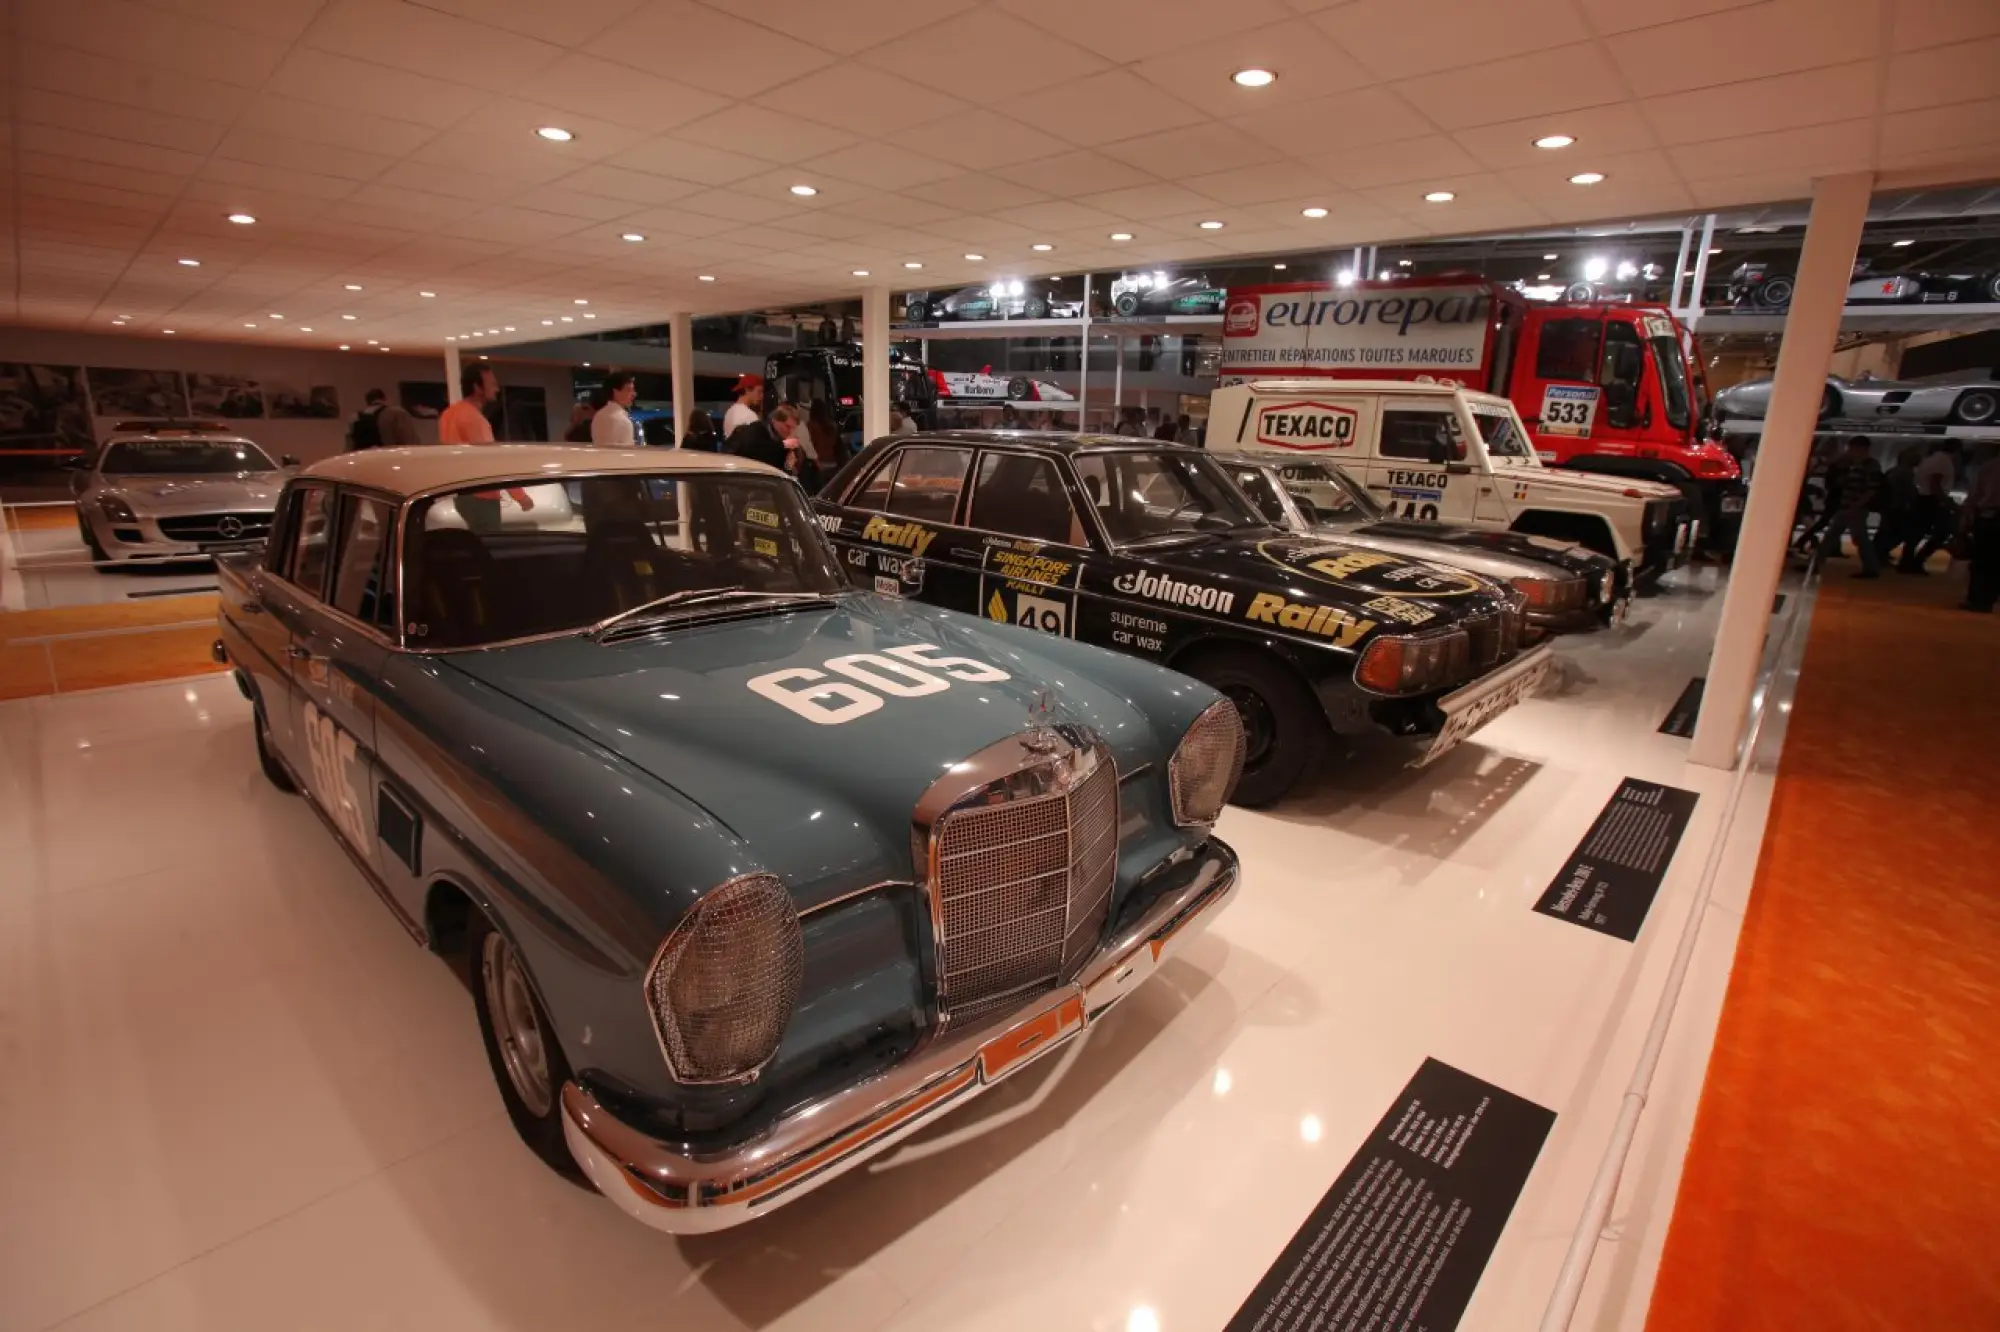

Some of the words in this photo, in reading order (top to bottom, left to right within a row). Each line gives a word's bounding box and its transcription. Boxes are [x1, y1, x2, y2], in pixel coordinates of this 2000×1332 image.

[1265, 294, 1492, 336] eurorepar
[1222, 347, 1276, 363] ENTRETIEN
[1279, 346, 1355, 363] RÉPARATIONS
[1360, 348, 1404, 364] TOUTES
[1408, 347, 1474, 364] MARQUES
[1546, 401, 1590, 424] 533
[1265, 412, 1351, 439] TEXACO
[1388, 470, 1448, 488] TEXACO
[862, 515, 938, 557] Rally
[847, 548, 870, 567] car
[993, 551, 1073, 576] SINGAPORE
[1000, 565, 1062, 586] AIRLINES
[1018, 606, 1062, 636] 49
[1113, 569, 1235, 615] Johnson
[1245, 592, 1378, 649] Rally
[1110, 611, 1168, 633] supreme
[1112, 629, 1134, 644] car
[1137, 635, 1163, 653] wax
[746, 643, 1012, 725] 605
